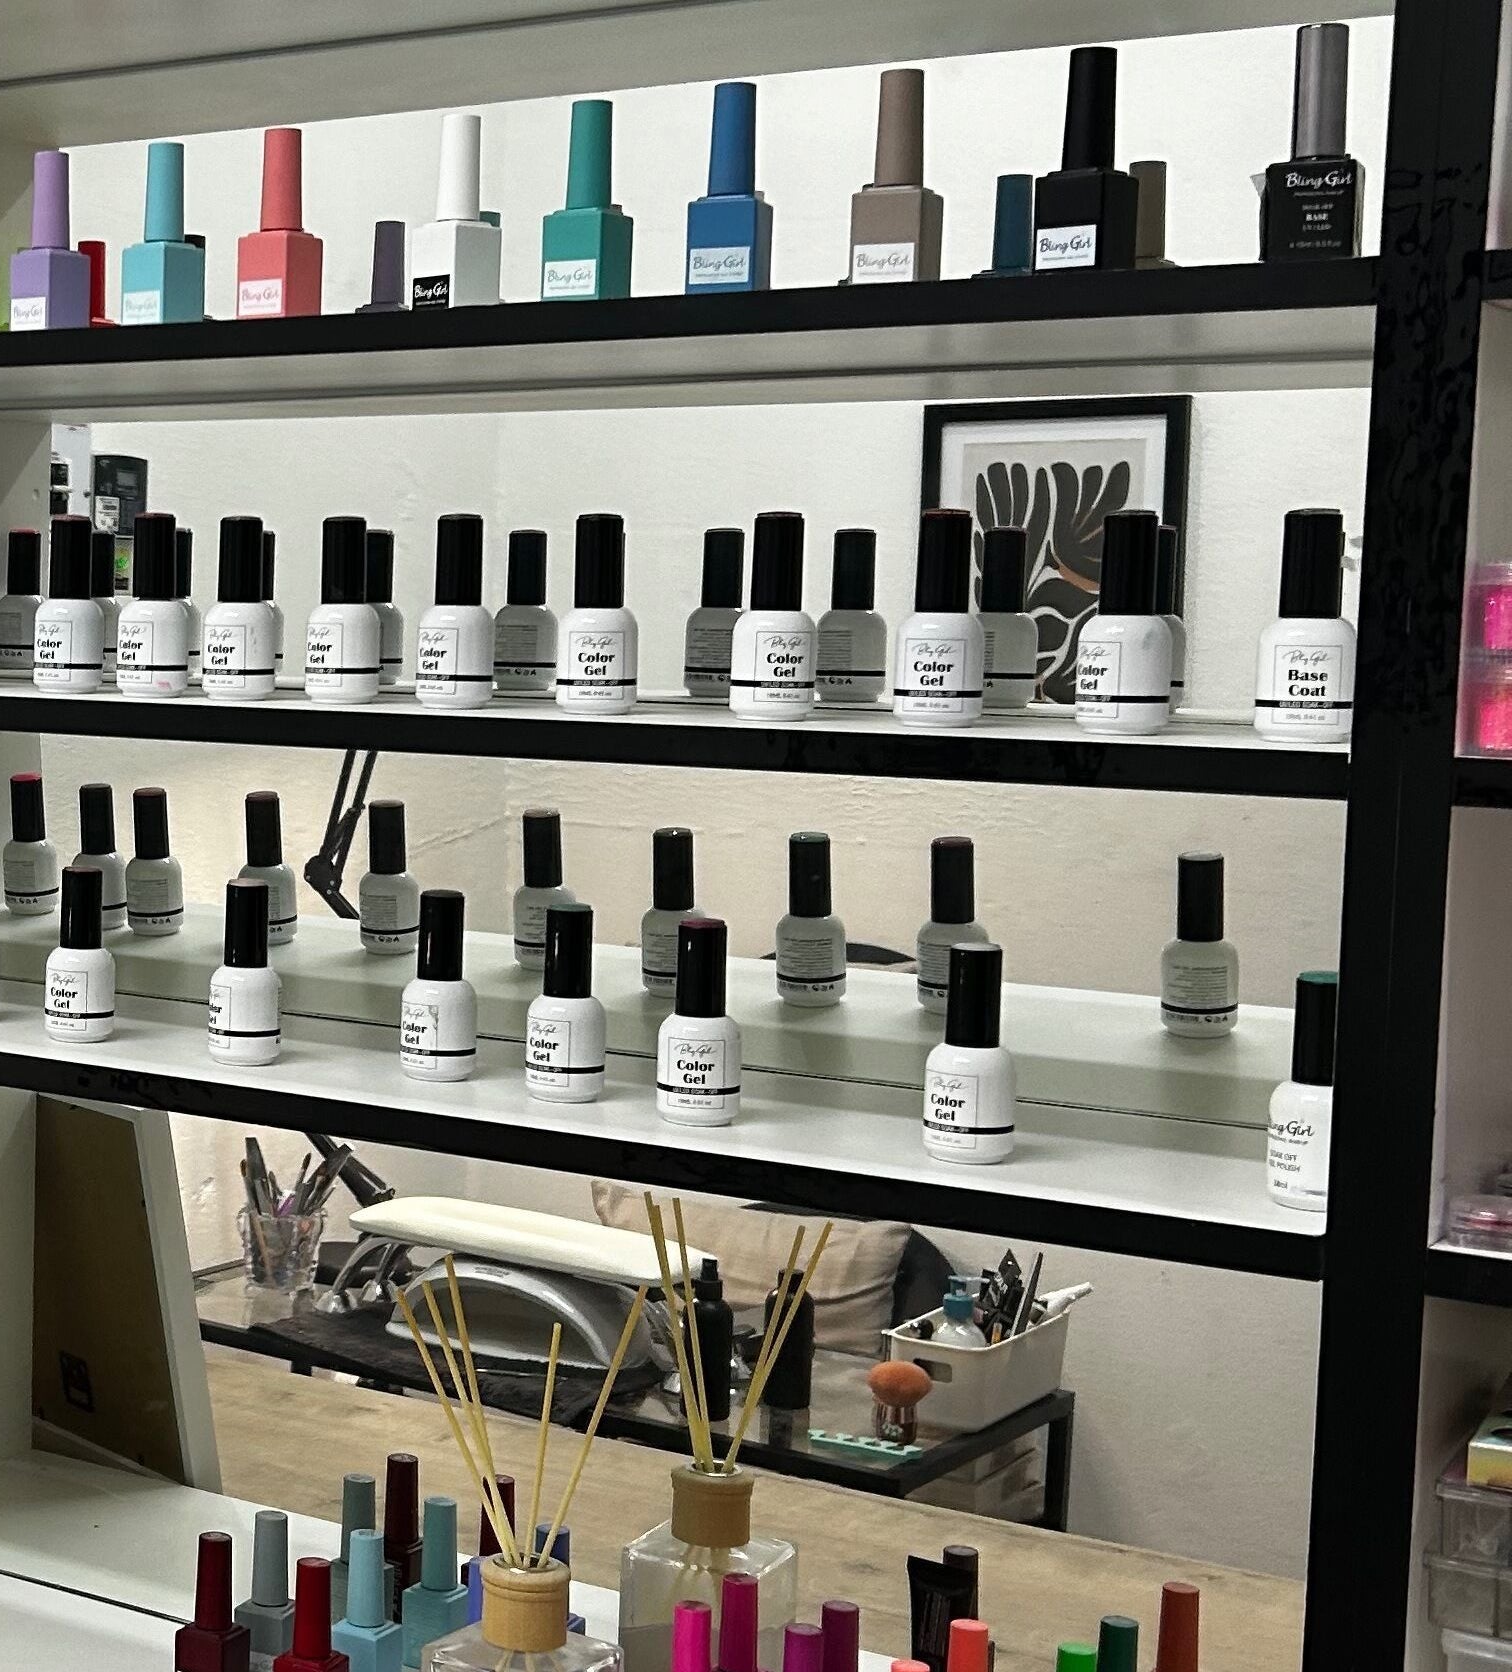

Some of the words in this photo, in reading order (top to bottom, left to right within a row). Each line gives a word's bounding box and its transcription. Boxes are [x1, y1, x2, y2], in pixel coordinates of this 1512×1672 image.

[1286, 172, 1324, 189] Bling
[1324, 169, 1352, 187] Girl
[1040, 237, 1068, 254] Bling
[1070, 235, 1092, 250] Girl
[693, 256, 722, 271] Bling
[722, 255, 745, 269] Girl
[857, 253, 887, 269] Bling
[888, 252, 910, 266] Girl
[37, 639, 63, 649] Color
[119, 639, 143, 650] Color
[208, 643, 236, 654] Color
[308, 642, 333, 652] Color
[39, 650, 55, 660] Gel
[121, 651, 136, 661] Gel
[310, 654, 325, 664] Gel
[419, 647, 448, 659] Color
[578, 652, 615, 663] Color
[766, 653, 804, 665] Color
[211, 656, 227, 666] Gel
[422, 660, 438, 671] Gel
[914, 661, 954, 673] Color
[584, 665, 607, 676] Gel
[773, 666, 796, 678] Gel
[1288, 669, 1328, 681] Base
[920, 674, 944, 686] Gel
[1081, 679, 1098, 690] Gel
[1288, 684, 1327, 697] Coat
[50, 986, 78, 998] Color
[53, 998, 70, 1009] Gel
[402, 1021, 427, 1033] Color
[405, 1034, 420, 1045] Gel
[530, 1037, 559, 1051] Color
[533, 1051, 550, 1062] Gel
[677, 1059, 715, 1072] Color
[683, 1073, 706, 1085] Gel
[931, 1093, 965, 1108] Color
[935, 1109, 956, 1121] Gel
[1286, 1120, 1316, 1137] Girl
